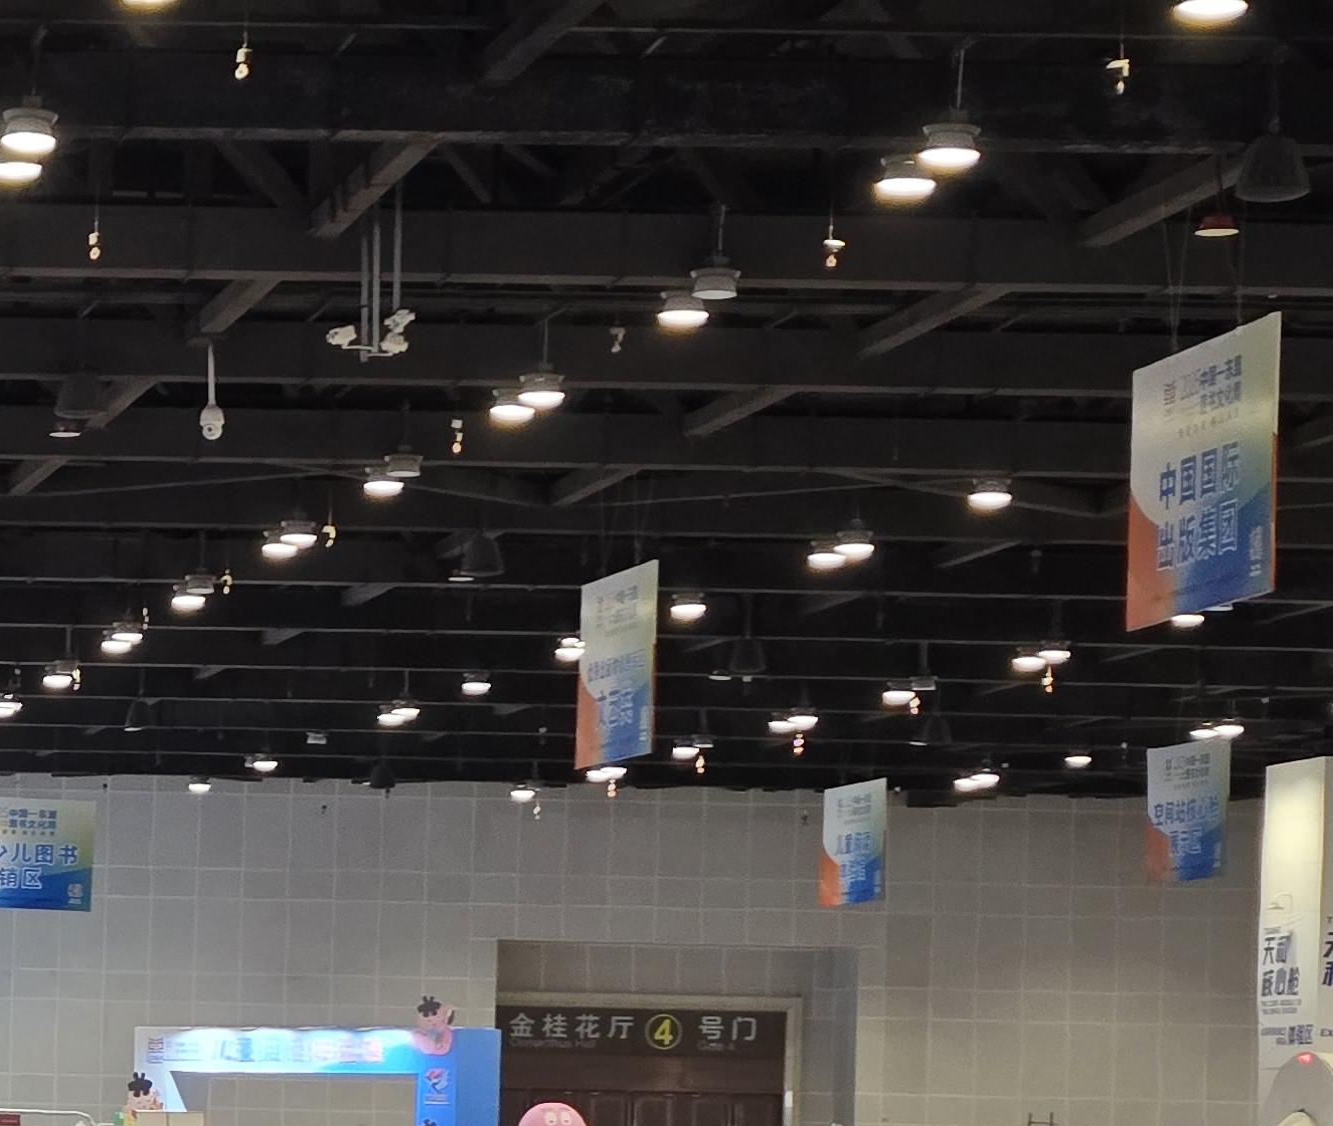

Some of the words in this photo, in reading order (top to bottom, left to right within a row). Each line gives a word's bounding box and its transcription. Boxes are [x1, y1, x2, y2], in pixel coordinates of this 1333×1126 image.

[1159, 438, 1239, 513] 中国国际
[1157, 496, 1238, 574] 出版集团
[509, 1013, 634, 1039] 金桂花厅
[654, 1019, 674, 1045] 4
[698, 1016, 757, 1041] 号门
